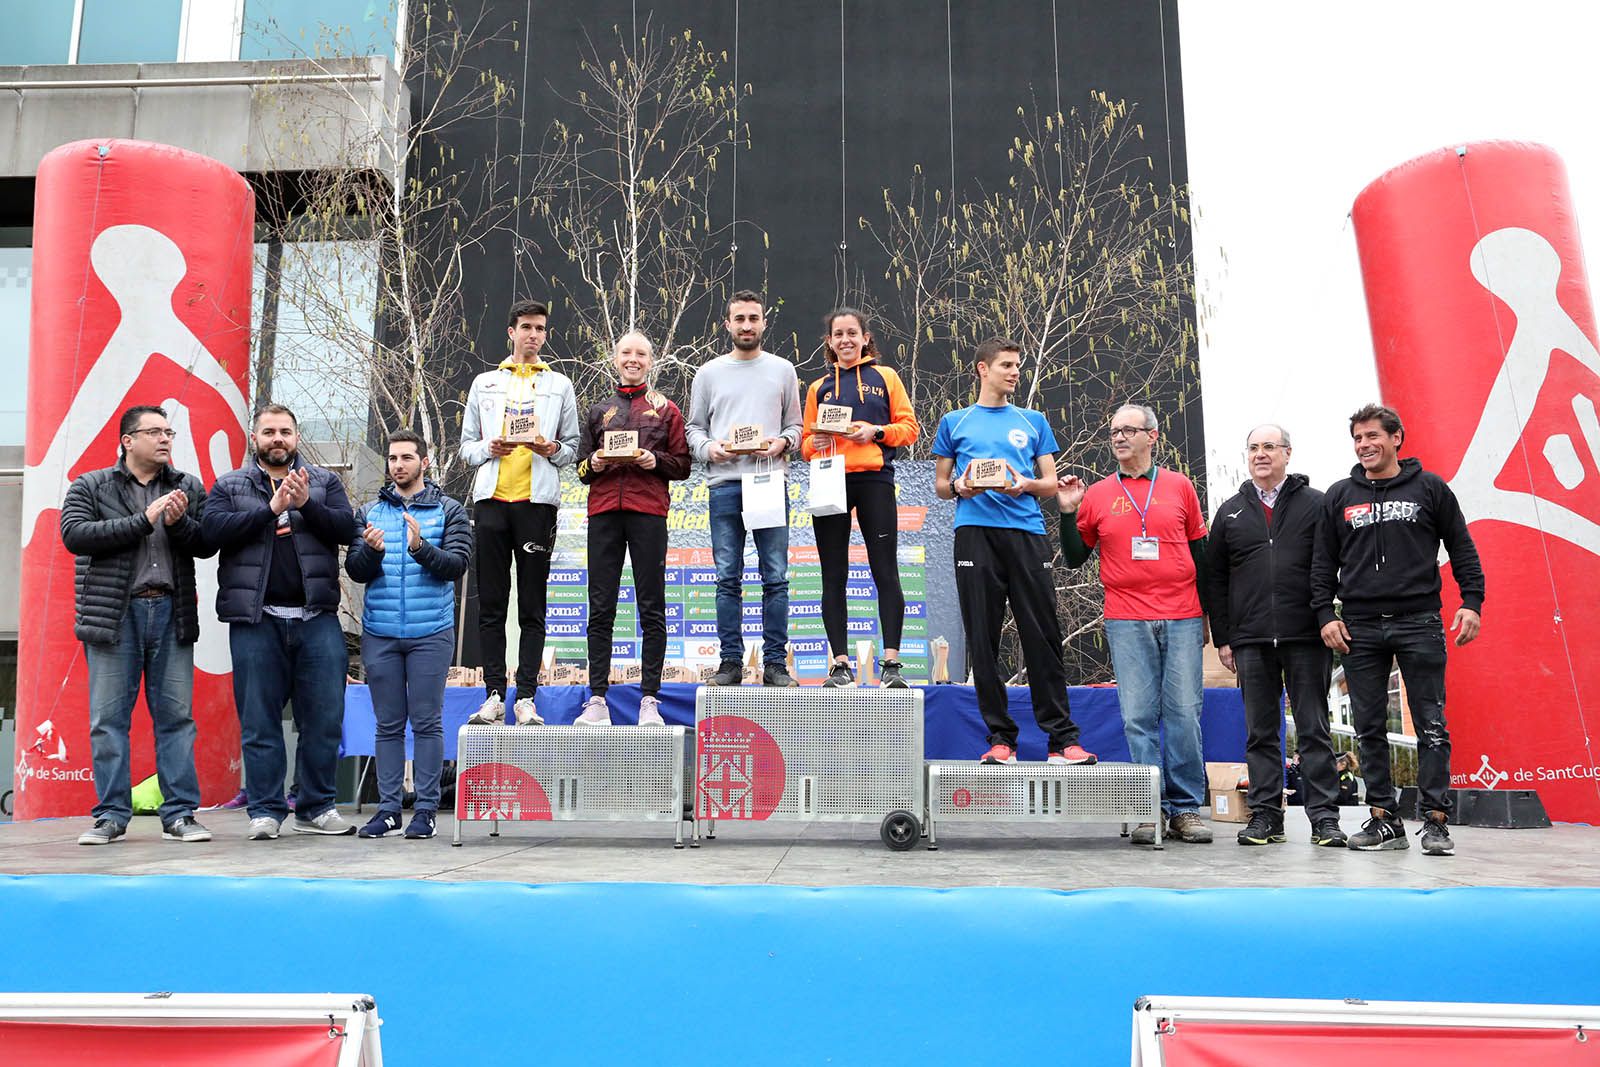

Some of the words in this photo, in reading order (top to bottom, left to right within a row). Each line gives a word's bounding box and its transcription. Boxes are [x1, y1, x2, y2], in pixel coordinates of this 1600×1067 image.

[667, 510, 710, 530] Med
[690, 572, 719, 583] Jom
[848, 570, 871, 579] ma
[546, 606, 582, 617] Joma
[788, 604, 823, 616] Joma
[546, 623, 582, 634] Joma
[690, 623, 718, 634] Jom
[612, 644, 631, 655] ma
[36, 766, 49, 780] de
[52, 767, 95, 781] SantCu
[1514, 767, 1534, 782] de
[1536, 763, 1600, 782] SantCug
